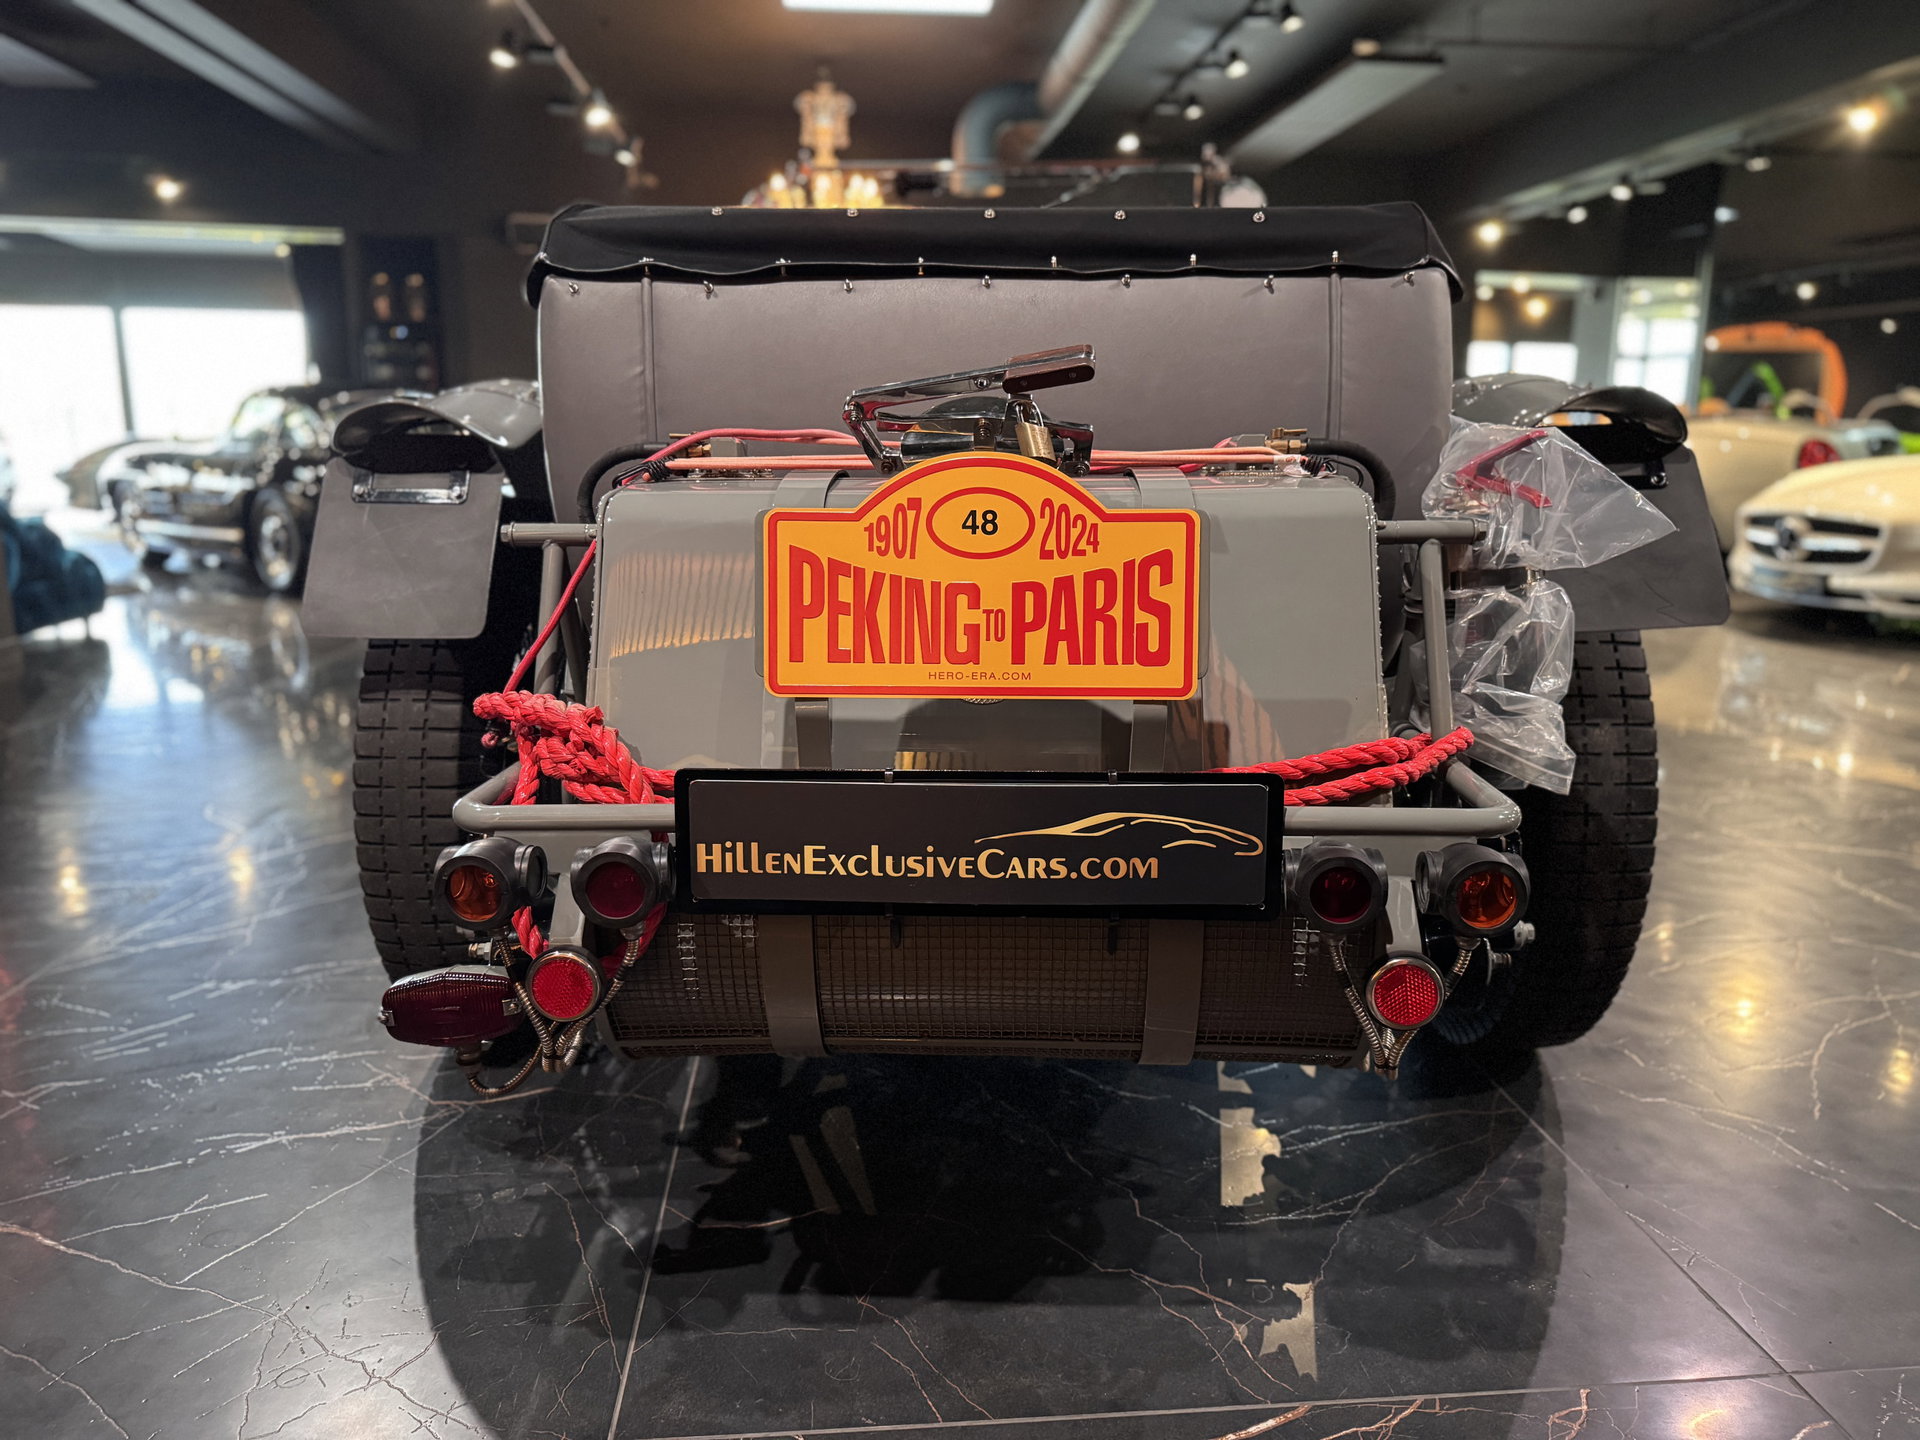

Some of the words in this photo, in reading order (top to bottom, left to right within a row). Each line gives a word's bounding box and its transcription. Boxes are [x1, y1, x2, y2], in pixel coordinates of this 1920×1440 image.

[864, 497, 922, 560] 1907
[961, 509, 999, 536] 48
[1039, 497, 1100, 560] 2024
[788, 544, 981, 665] PEKING
[982, 608, 1006, 642] TO
[1010, 548, 1174, 667] PARIS
[928, 671, 1032, 681] HERO-ERA.COM
